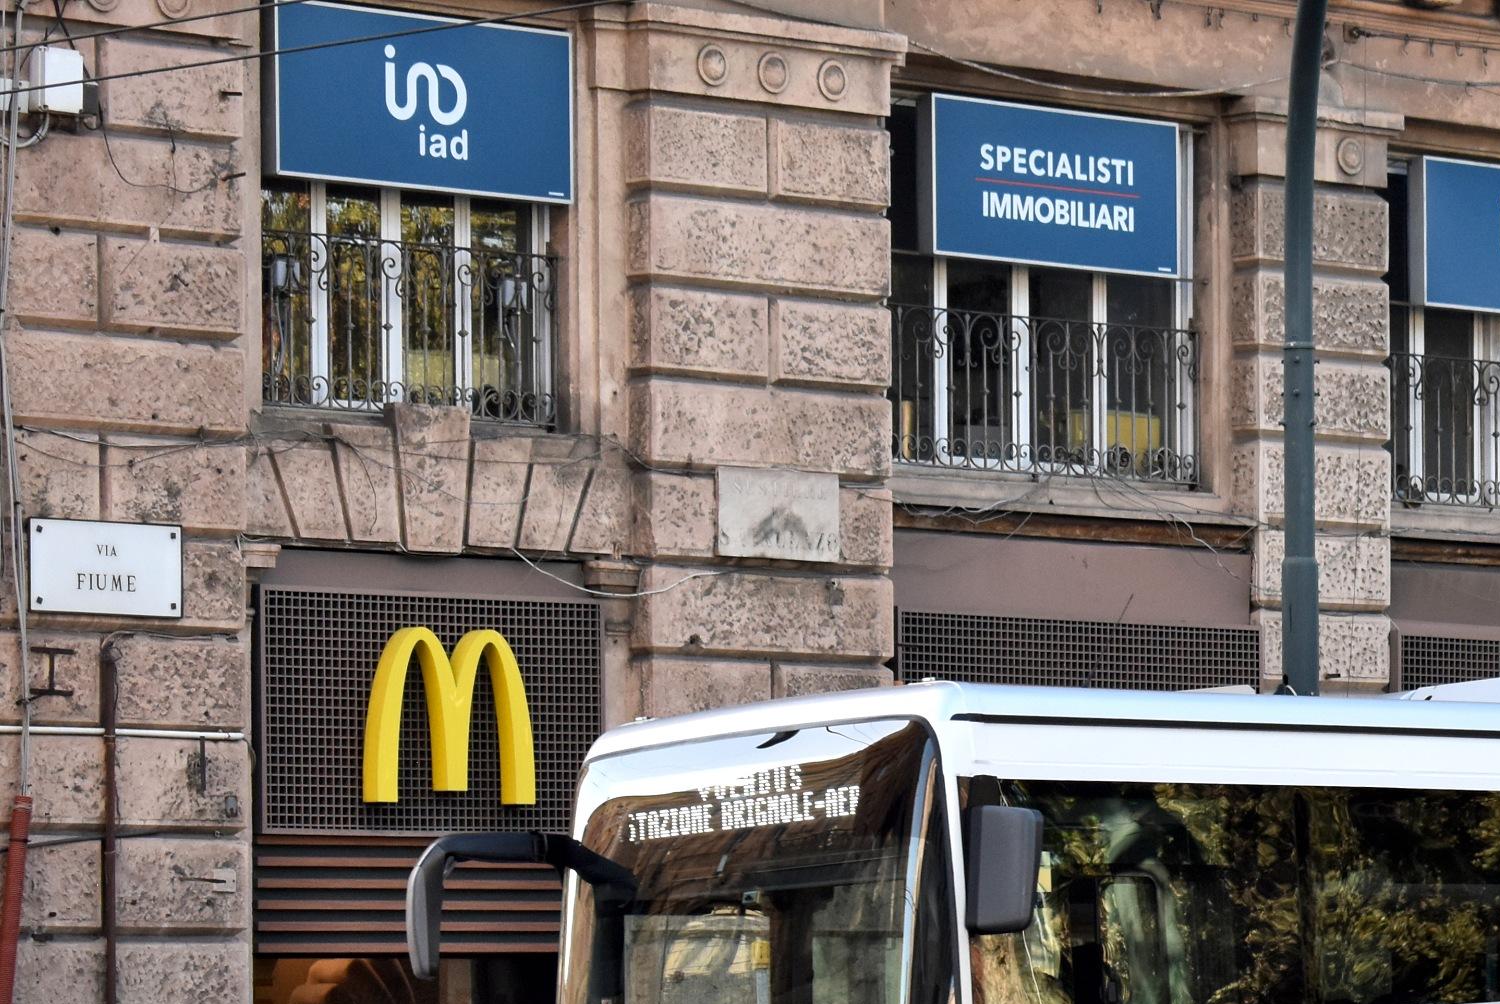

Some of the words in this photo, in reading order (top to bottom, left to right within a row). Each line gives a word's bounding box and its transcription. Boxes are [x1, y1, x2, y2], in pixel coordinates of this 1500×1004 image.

[418, 124, 469, 161] iad
[980, 143, 1134, 186] SPECIALISTI
[982, 190, 1135, 233] IMMOBILIARI
[96, 544, 118, 557] VIA
[76, 572, 137, 593] FIUME
